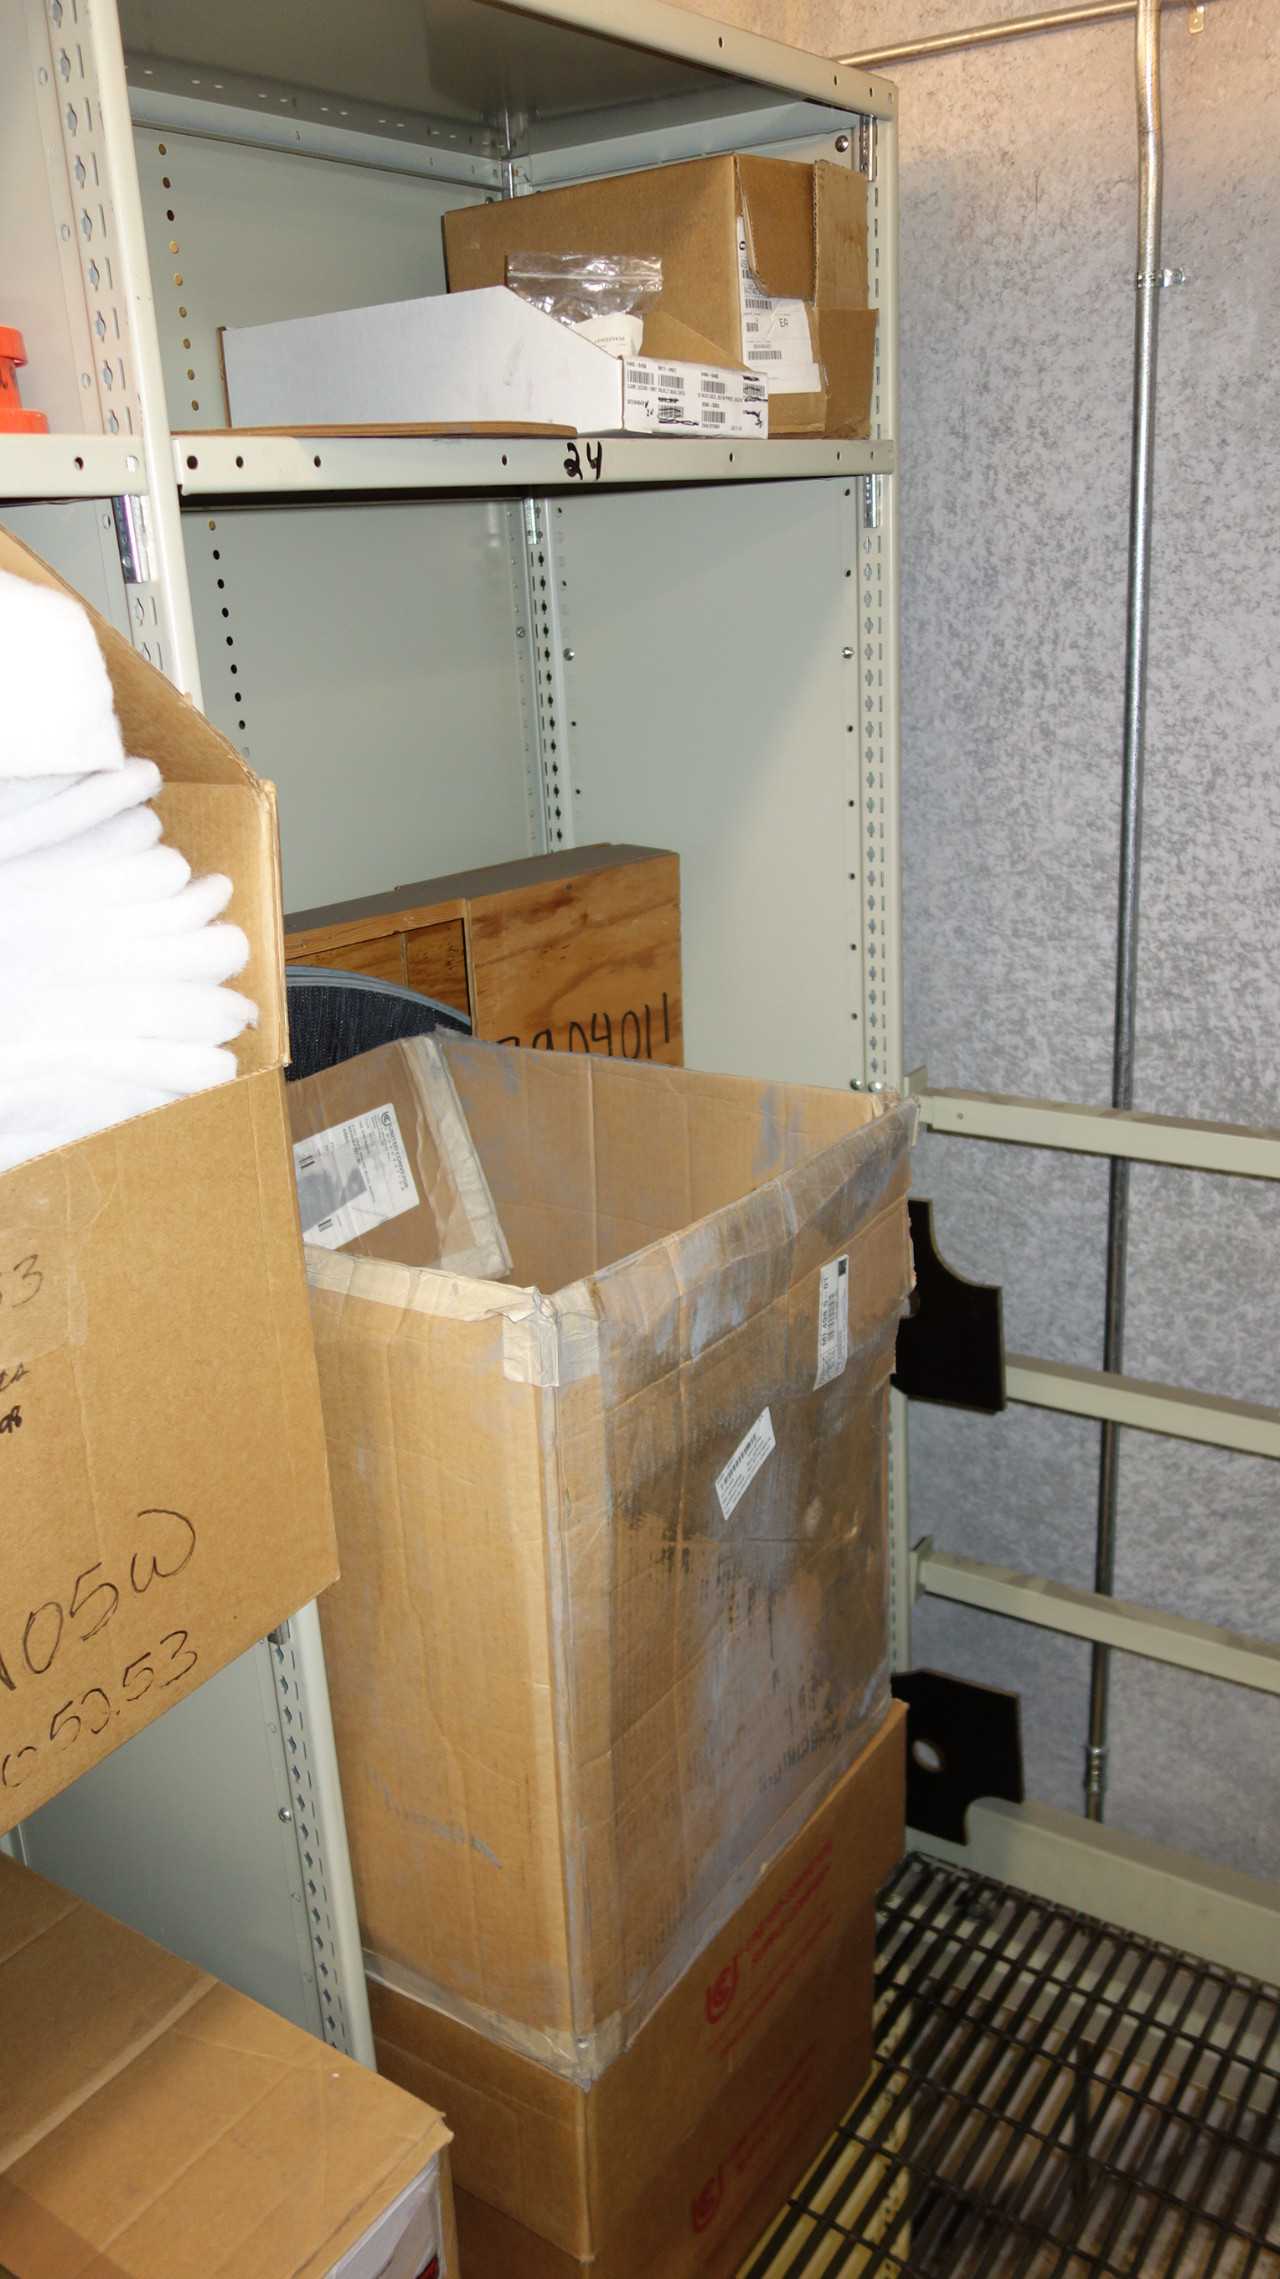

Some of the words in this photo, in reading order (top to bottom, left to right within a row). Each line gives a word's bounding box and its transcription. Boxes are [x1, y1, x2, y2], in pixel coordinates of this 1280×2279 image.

[563, 440, 602, 480] 24
[496, 992, 670, 1059] 04011
[0, 1510, 196, 1691] 05W
